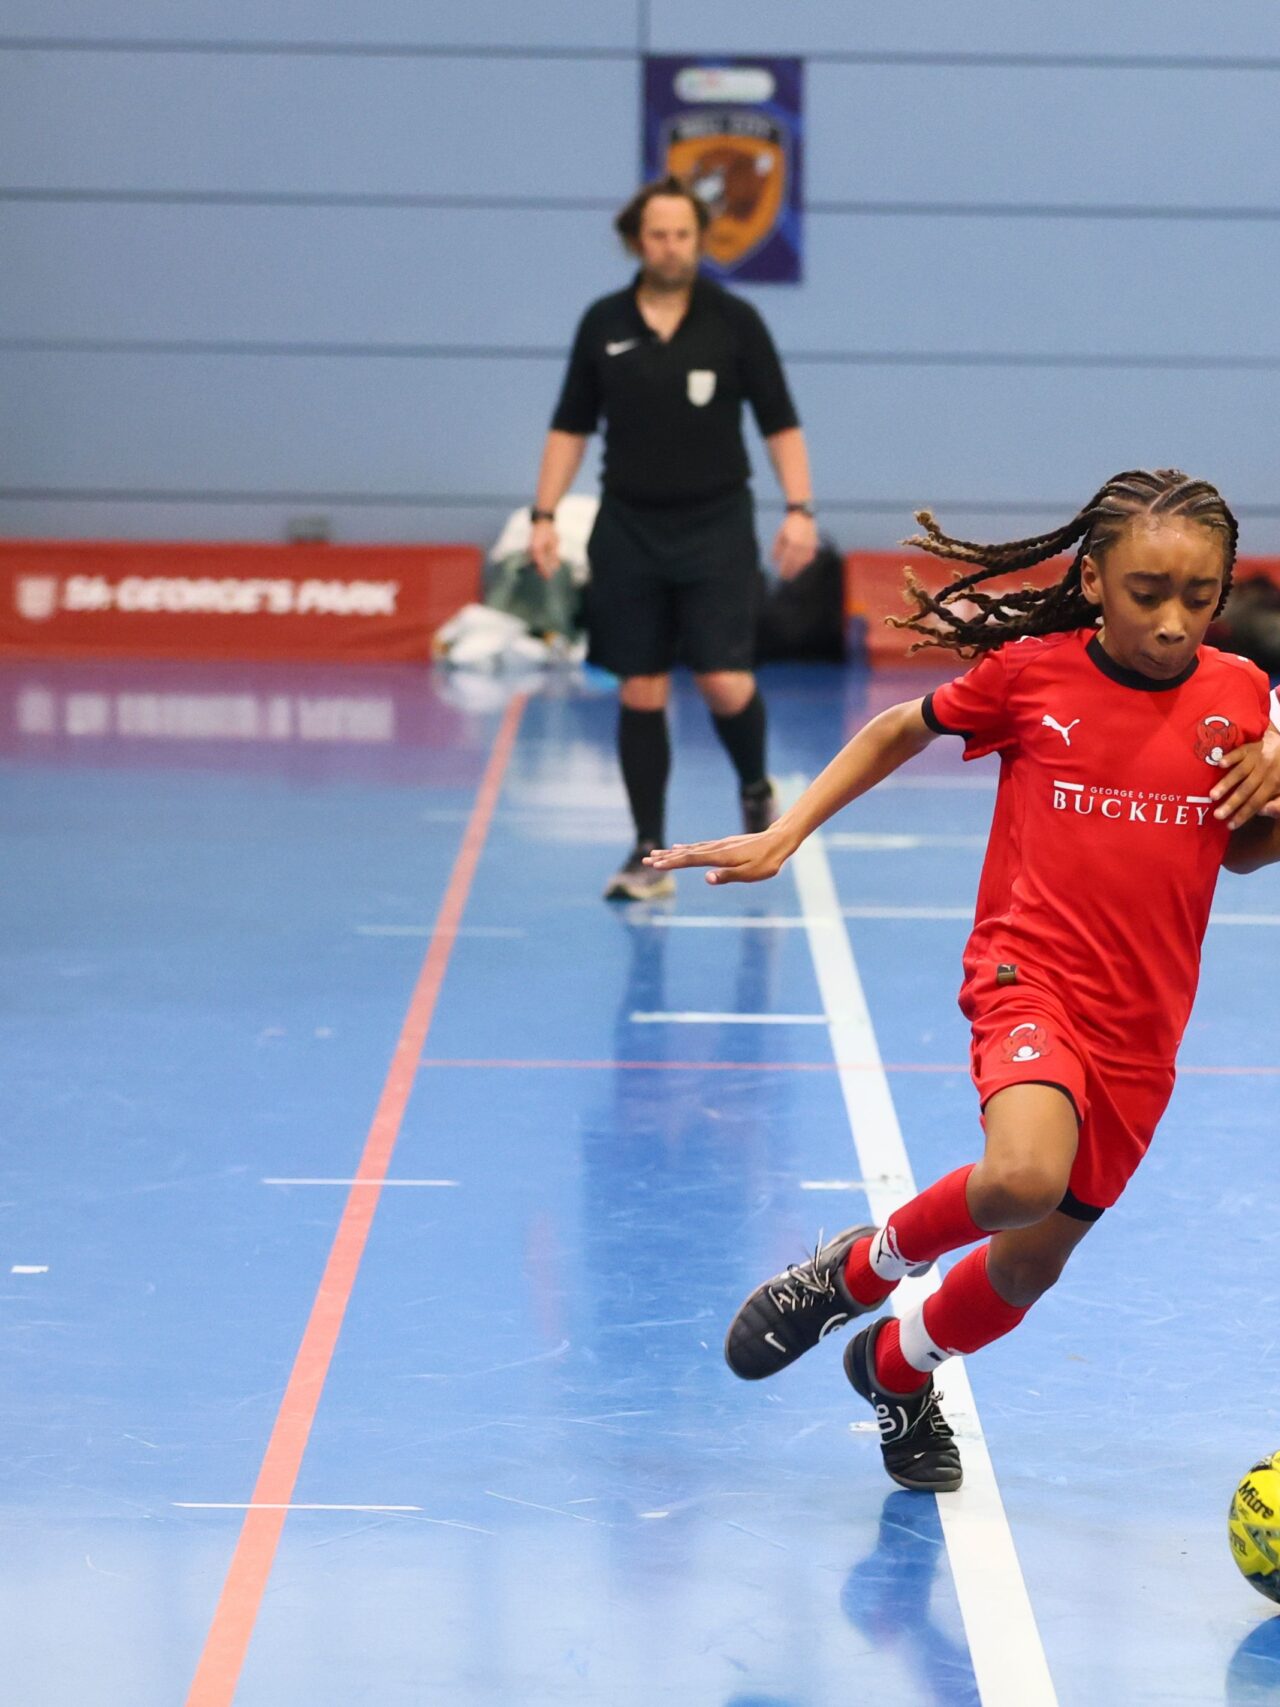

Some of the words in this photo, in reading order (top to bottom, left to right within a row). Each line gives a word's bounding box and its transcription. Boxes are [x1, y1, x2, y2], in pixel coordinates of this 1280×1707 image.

[297, 579, 398, 616] PARK
[1053, 789, 1210, 826] BUCKLEY
[1090, 786, 1134, 798] GEORGE
[1149, 793, 1182, 802] PEGGY
